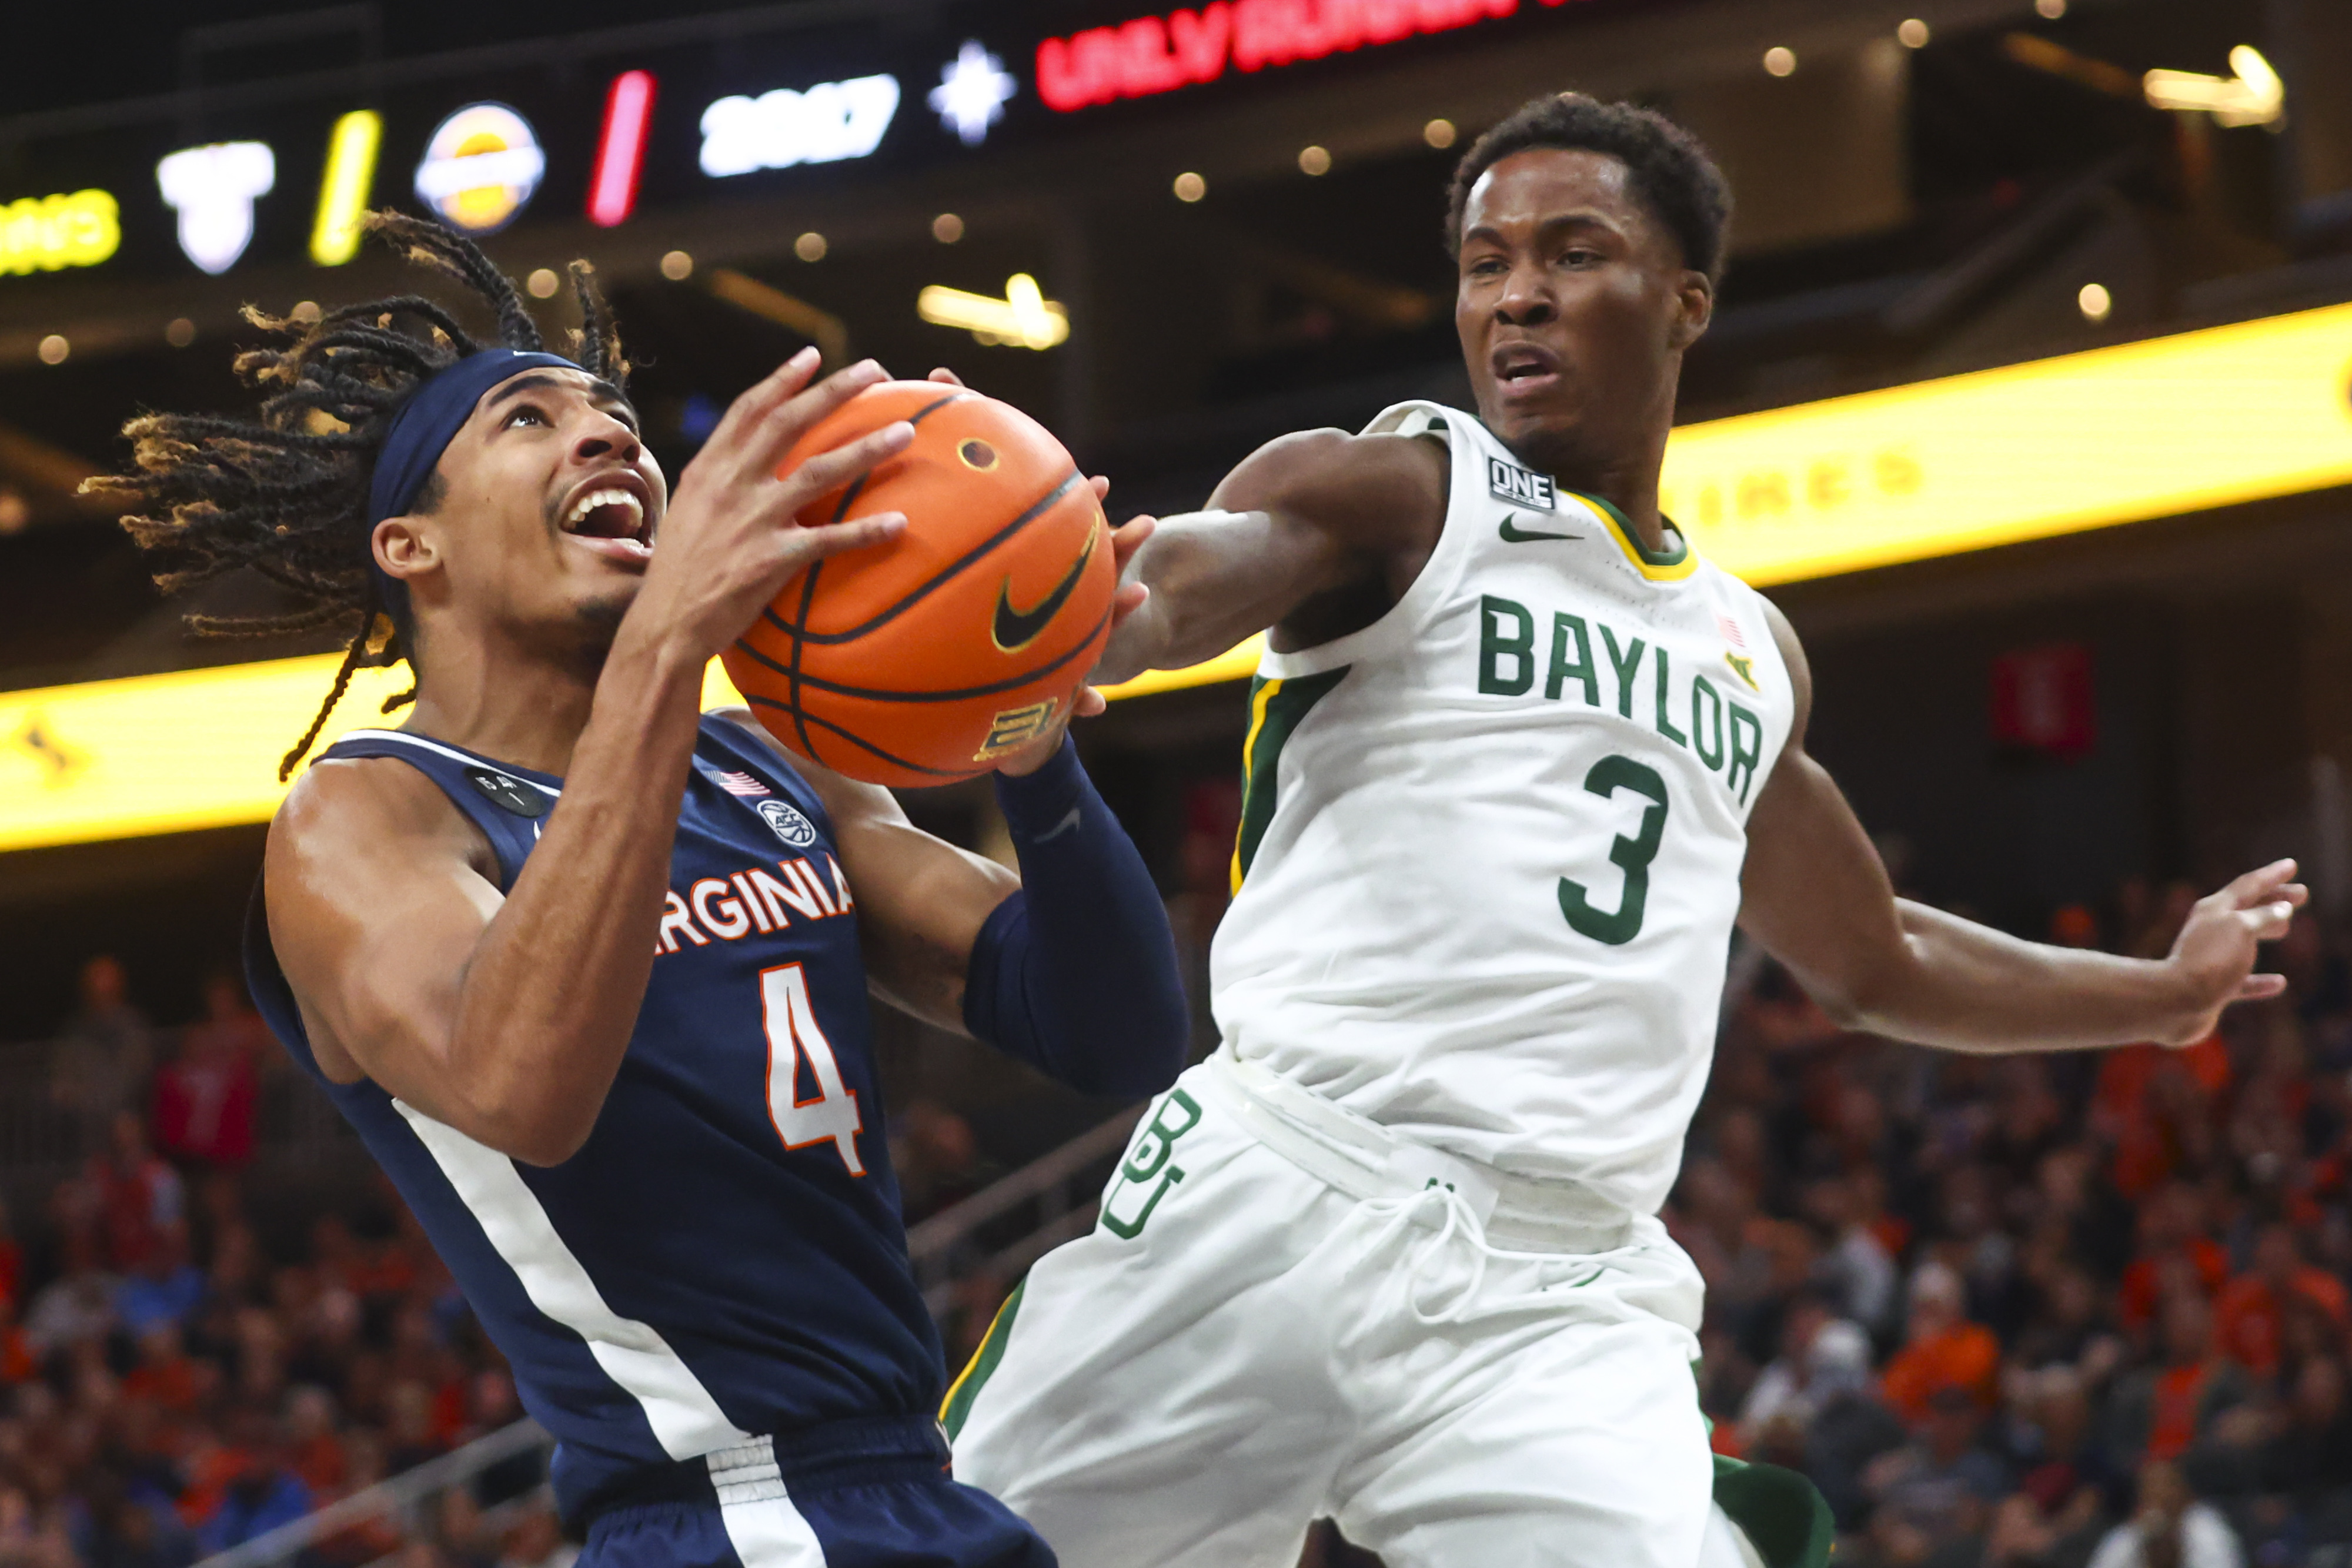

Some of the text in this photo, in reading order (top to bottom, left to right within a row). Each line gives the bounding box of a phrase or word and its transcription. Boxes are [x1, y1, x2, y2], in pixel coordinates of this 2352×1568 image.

[1492, 460, 1552, 502] ONE
[1479, 594, 1762, 809] BAYLOR
[654, 852, 855, 955] RGINIA
[1558, 755, 1668, 945] 3
[759, 961, 867, 1176] 4
